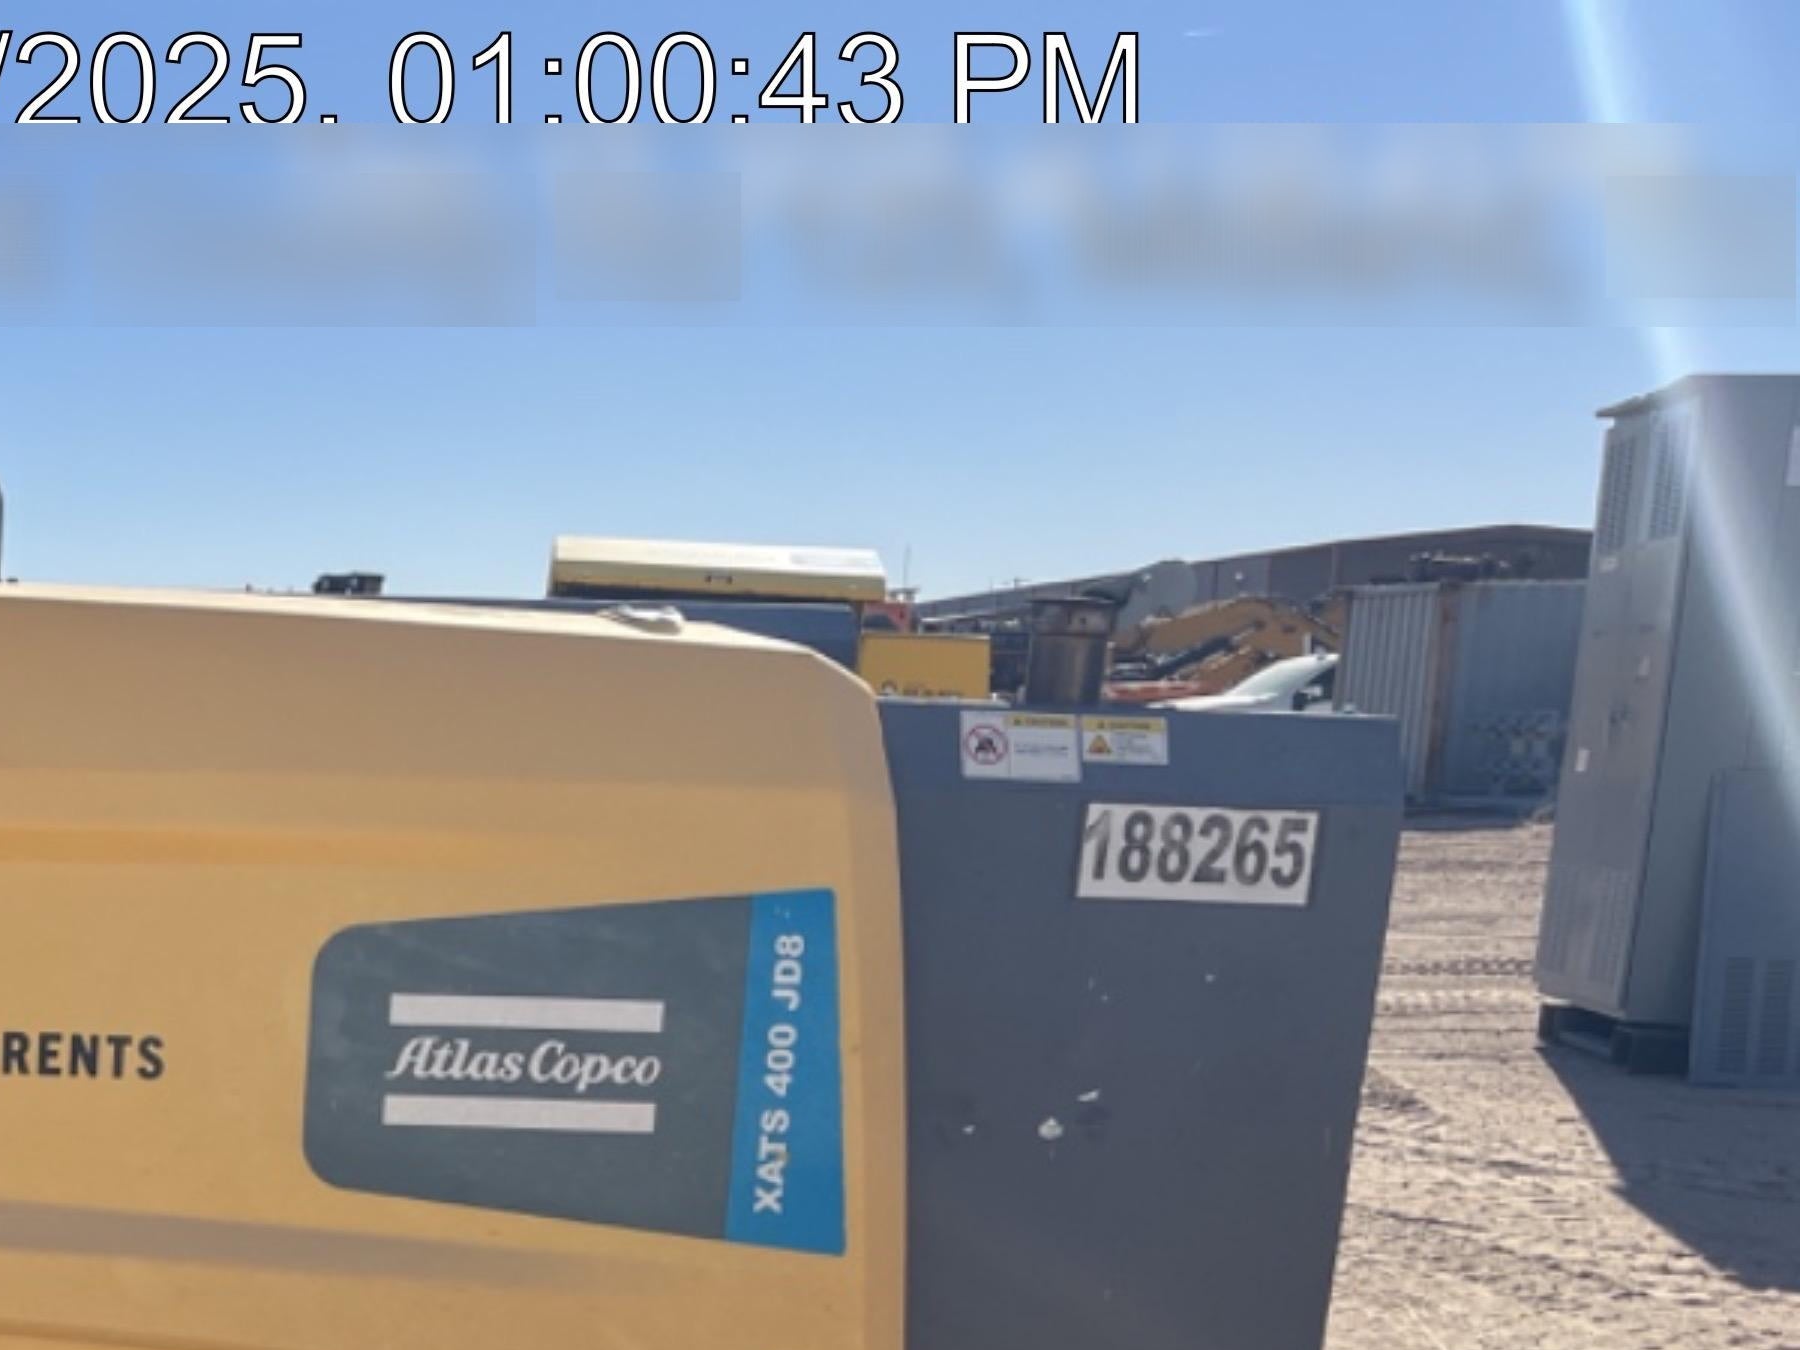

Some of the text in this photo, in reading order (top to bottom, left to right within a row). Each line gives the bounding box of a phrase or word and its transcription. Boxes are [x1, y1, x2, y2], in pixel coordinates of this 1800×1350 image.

[1084, 809, 1308, 889] 188265
[752, 934, 805, 1214] XATS 400 JD8
